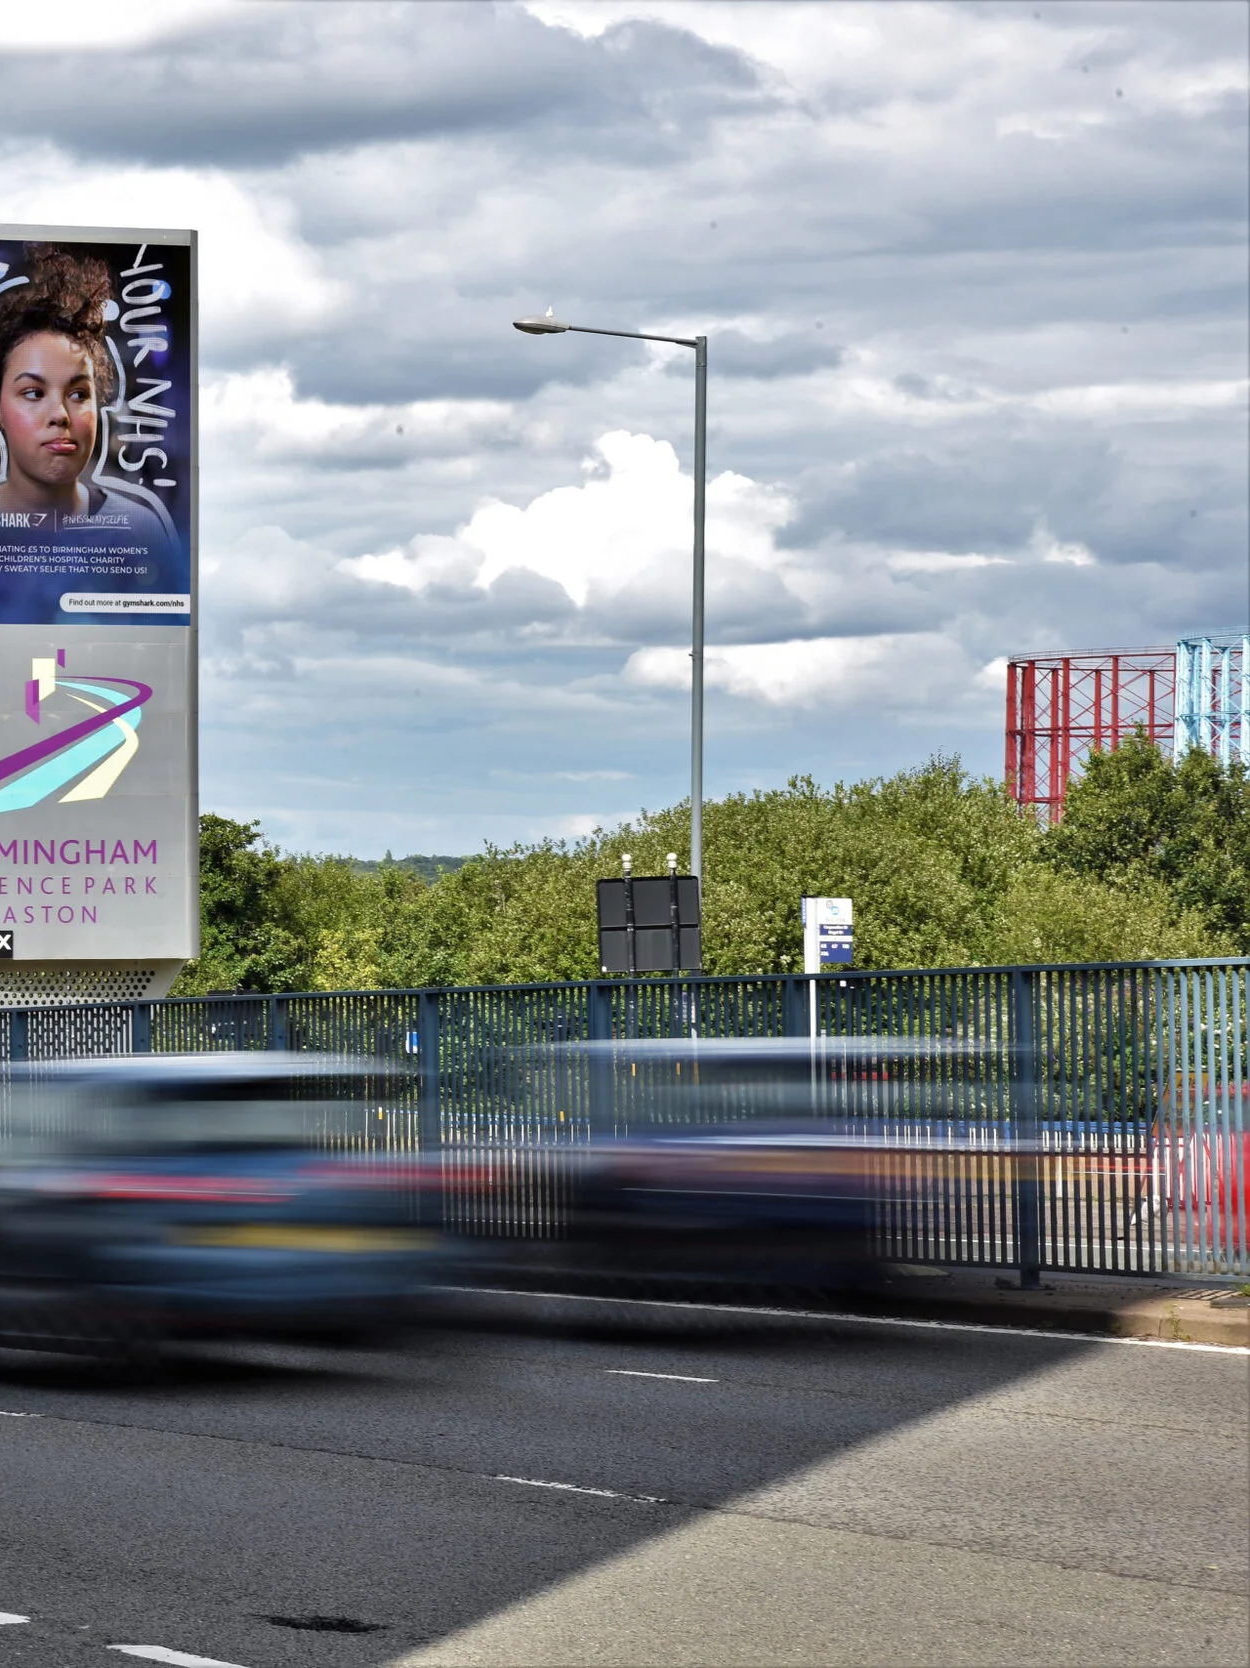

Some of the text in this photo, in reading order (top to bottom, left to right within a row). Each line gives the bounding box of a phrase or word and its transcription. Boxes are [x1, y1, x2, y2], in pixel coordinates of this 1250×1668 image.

[117, 243, 176, 486] YOUR NHS!
[27, 546, 38, 554] £5
[52, 546, 106, 554] BIRMINGHAM
[108, 547, 149, 555] WOMEN'S
[49, 556, 88, 564] HOSPITAL
[4, 564, 38, 573] SWEATY
[40, 565, 67, 573] SELFIE
[91, 566, 109, 574] YOU
[110, 566, 133, 574] SEND
[134, 566, 148, 574] US!
[68, 598, 83, 607] Find
[84, 599, 96, 607] out
[122, 600, 185, 608] gymshark.com/nhs
[84, 876, 158, 895] PARK
[2, 905, 97, 924] ASTON
